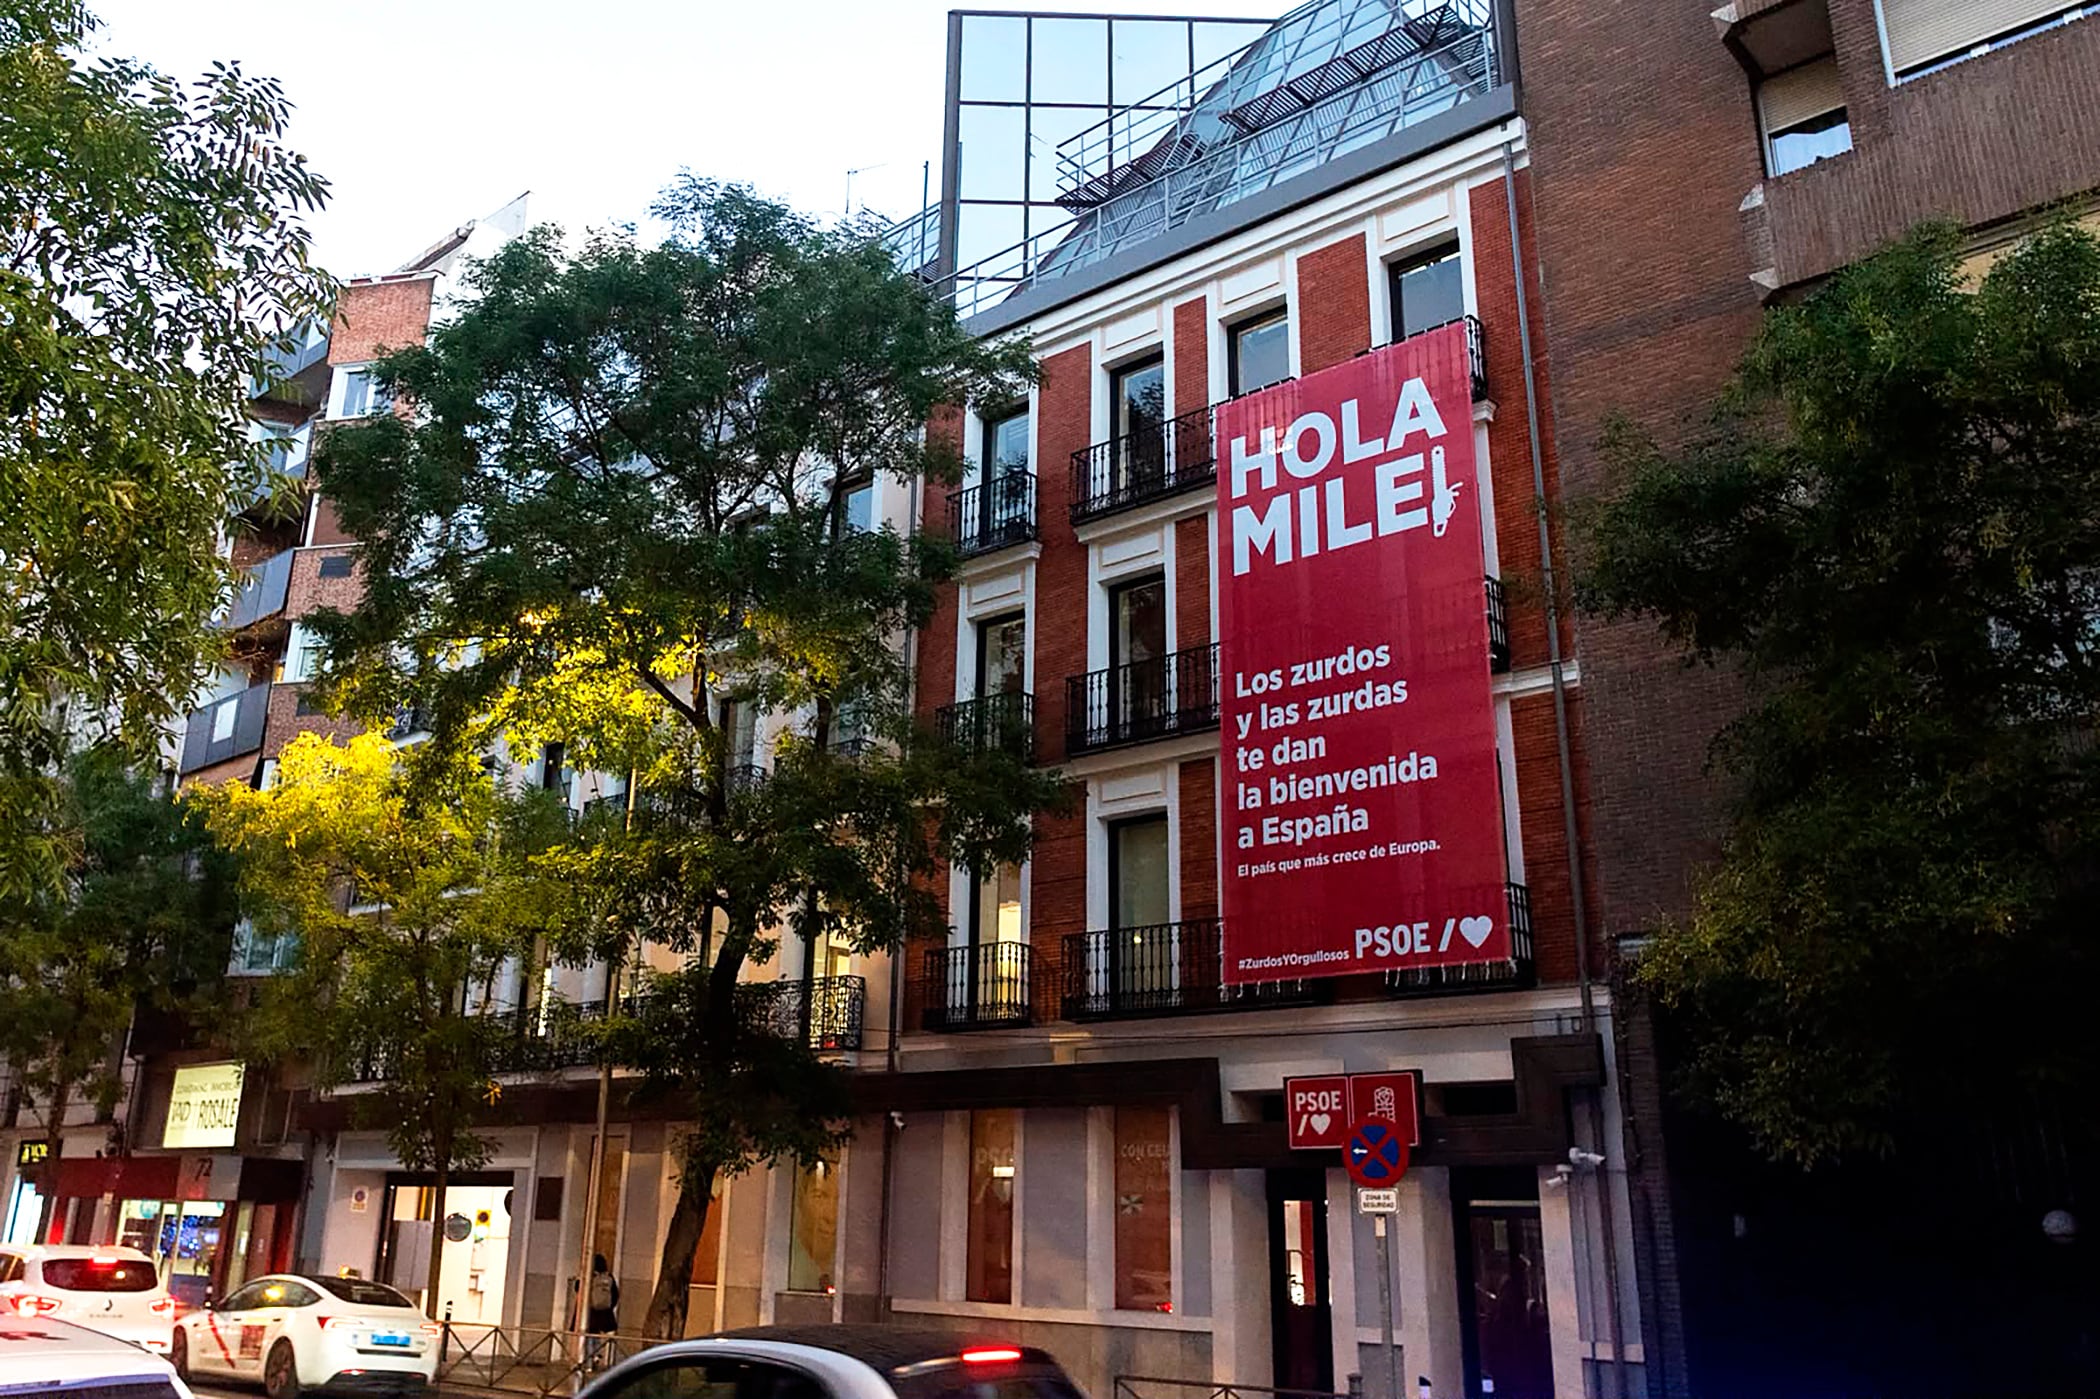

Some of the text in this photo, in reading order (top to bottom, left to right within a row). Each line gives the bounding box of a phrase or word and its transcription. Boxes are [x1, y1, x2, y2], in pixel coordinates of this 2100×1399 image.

[1231, 377, 1447, 498] HOLA
[1237, 645, 1391, 697] Los zurdos
[1237, 680, 1407, 740] y las zurdas
[1237, 736, 1326, 772] te dan
[1239, 752, 1437, 810] la bienvenida
[1239, 804, 1369, 849] a España
[1239, 839, 1441, 877] El país que más crece de Europa.
[1238, 949, 1350, 970] #ZurdosYOrgullosos
[1355, 922, 1431, 959] PSOE
[1294, 1090, 1342, 1112] PSOE
